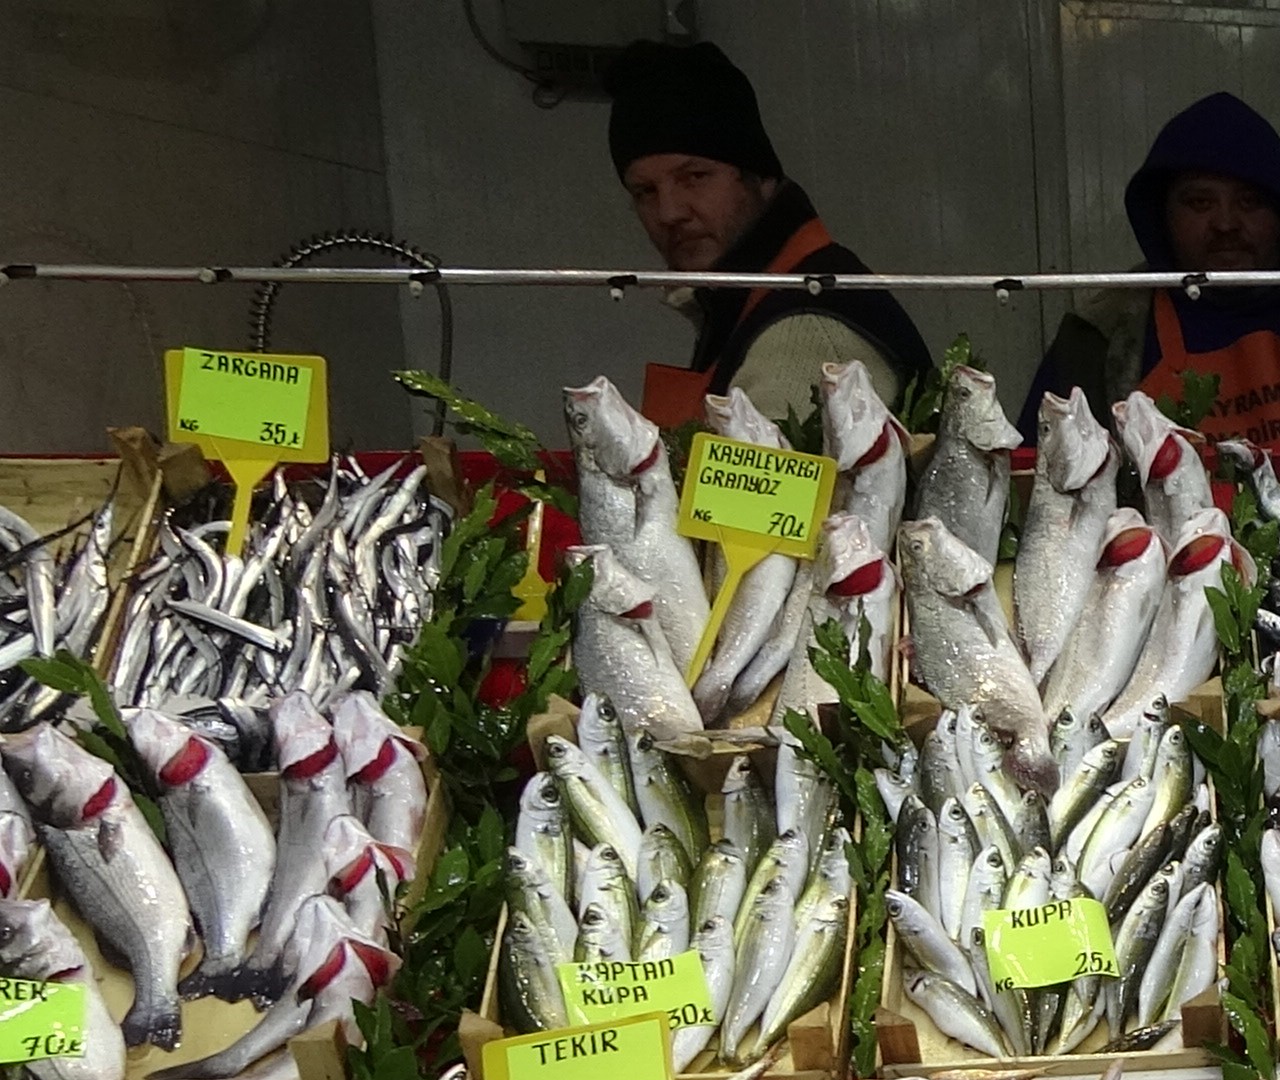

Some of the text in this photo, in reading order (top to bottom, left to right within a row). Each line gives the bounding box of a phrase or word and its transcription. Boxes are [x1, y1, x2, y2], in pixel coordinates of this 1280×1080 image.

[201, 353, 299, 385] ZARGANA
[180, 419, 199, 432] KG
[693, 508, 712, 522] KG
[1011, 900, 1072, 929] KUPA
[578, 958, 675, 983] KAPTAN
[583, 985, 649, 1006] KUPA
[995, 977, 1014, 994] KG
